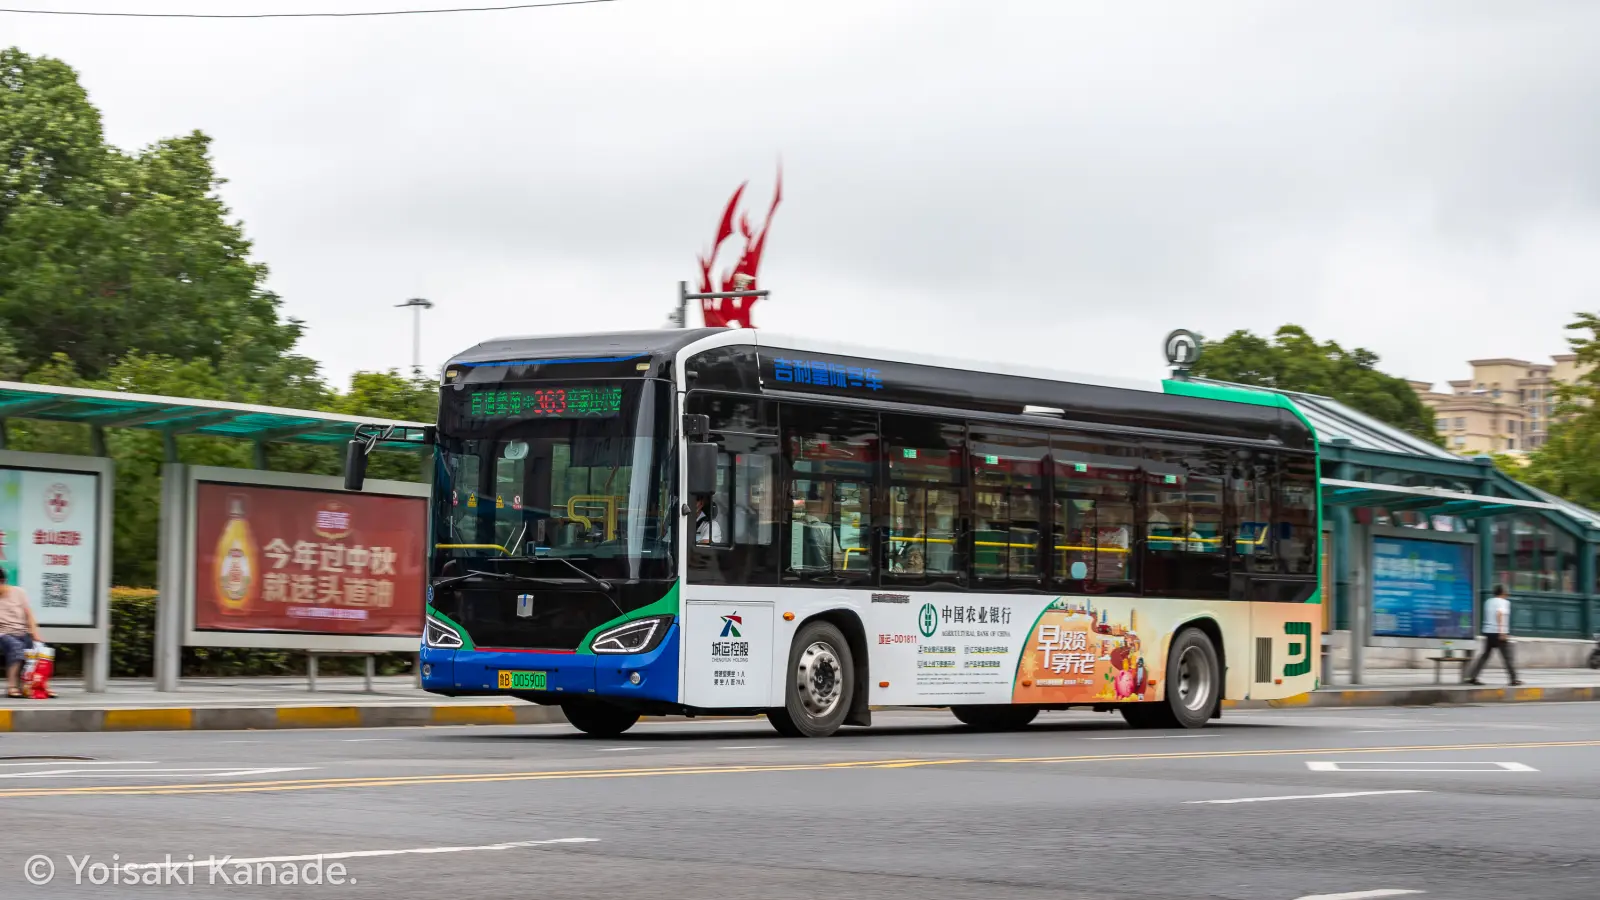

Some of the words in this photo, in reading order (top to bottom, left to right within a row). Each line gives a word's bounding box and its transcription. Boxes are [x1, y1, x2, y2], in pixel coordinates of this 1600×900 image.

[534, 389, 566, 413] 363
[263, 538, 397, 575] 今年过中秋
[942, 605, 1011, 624] 中国农业银行
[712, 642, 748, 656] 城运控股
